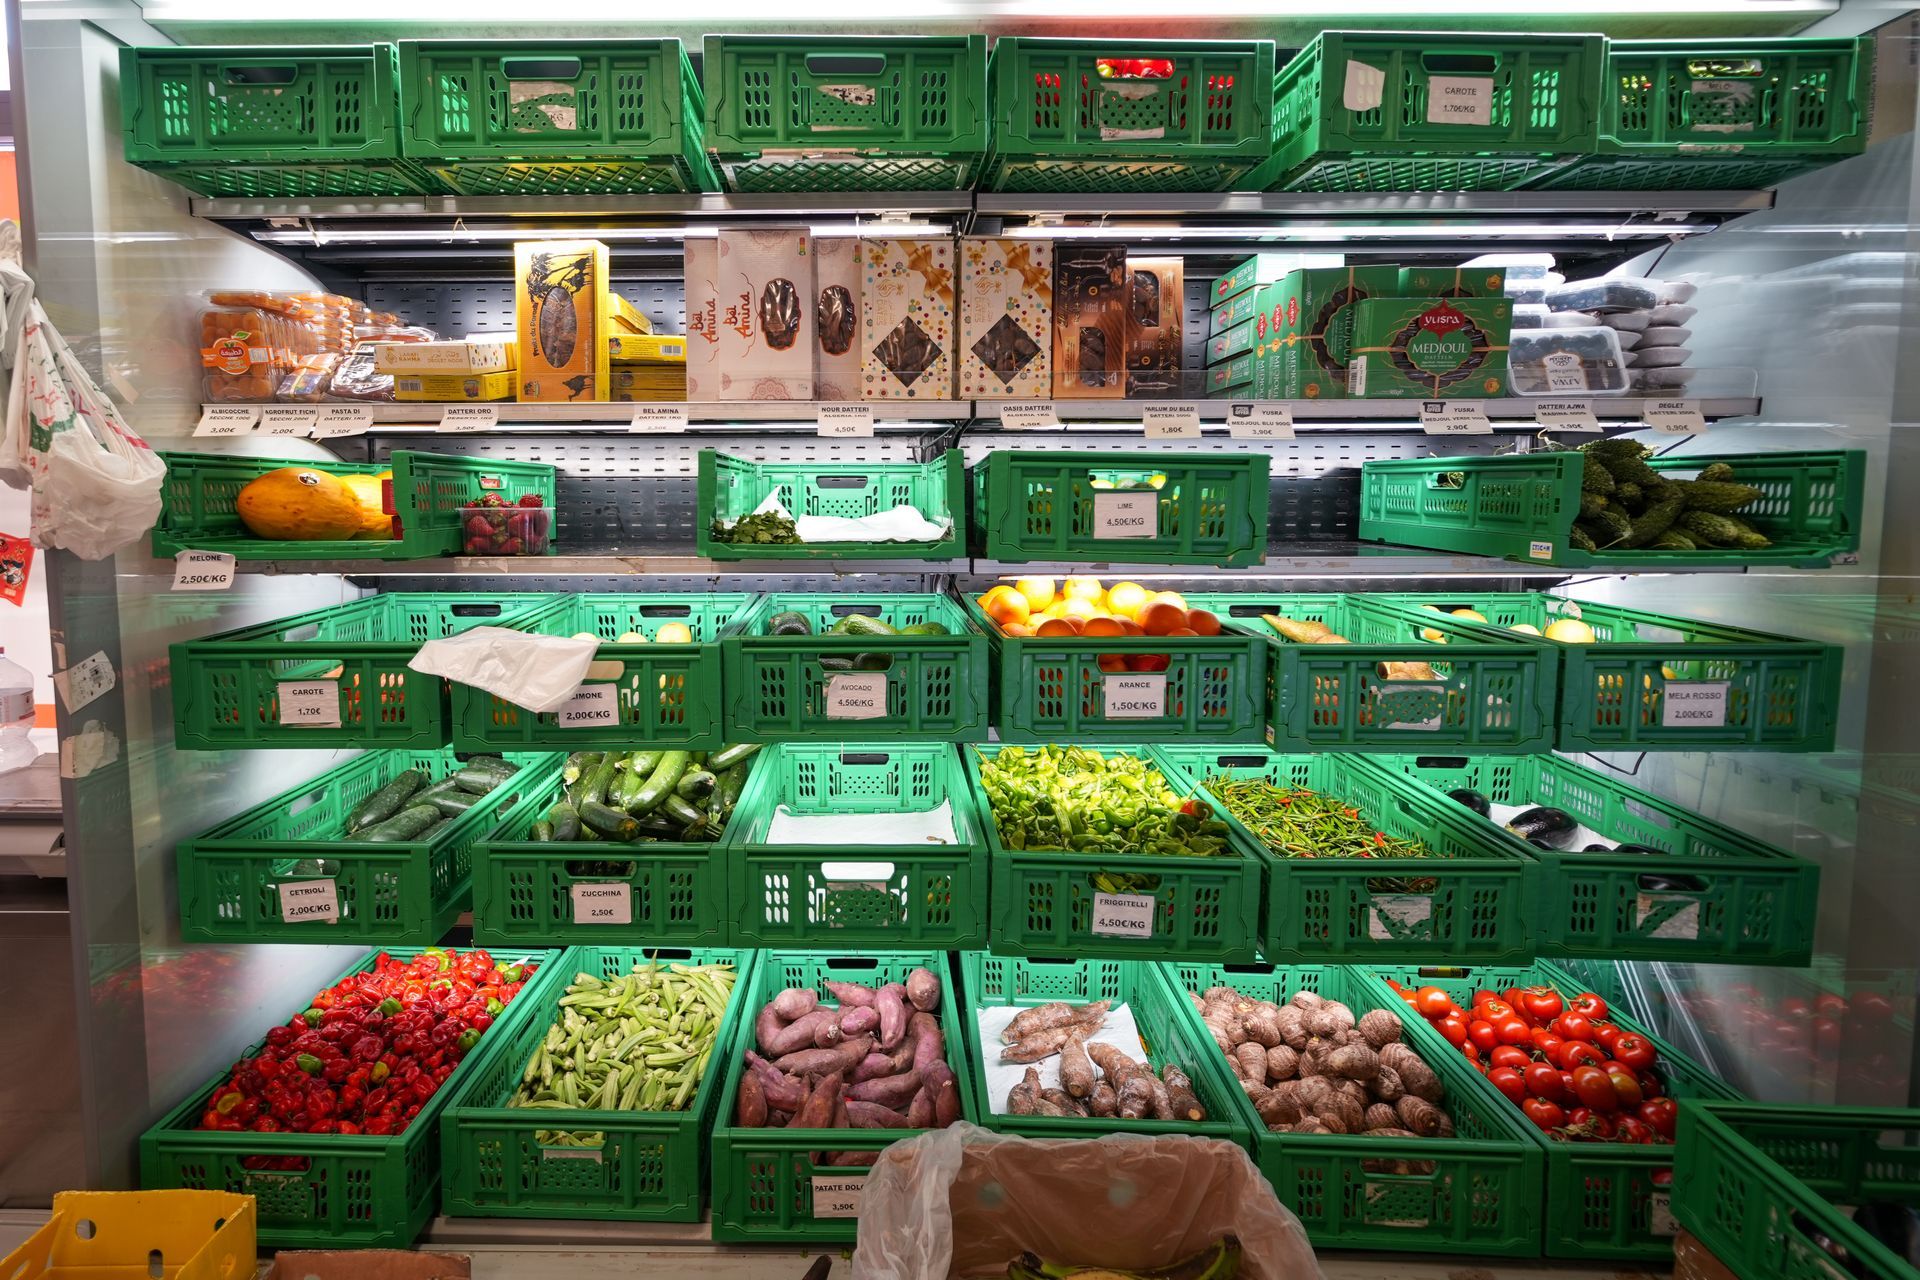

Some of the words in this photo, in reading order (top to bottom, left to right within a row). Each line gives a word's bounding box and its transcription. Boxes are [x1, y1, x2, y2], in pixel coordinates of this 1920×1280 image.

[1445, 87, 1477, 96] CAROTE
[734, 292, 754, 339] Amina
[700, 298, 719, 344] Amina
[1424, 315, 1460, 326] yusra
[1412, 343, 1468, 355] MEDJOUL
[1161, 426, 1183, 434] 1,80€
[180, 575, 227, 584] 2,50€/KG
[1111, 702, 1157, 711] 1,50€/KG
[566, 711, 611, 720] 2,00€/KG
[290, 887, 325, 896] CETRIOLI
[1100, 899, 1148, 908] FRIGGITELLI
[290, 904, 331, 915] 2,00€/KG
[1099, 919, 1145, 928] 4,50€/KG
[832, 1203, 854, 1211] 3,50€
